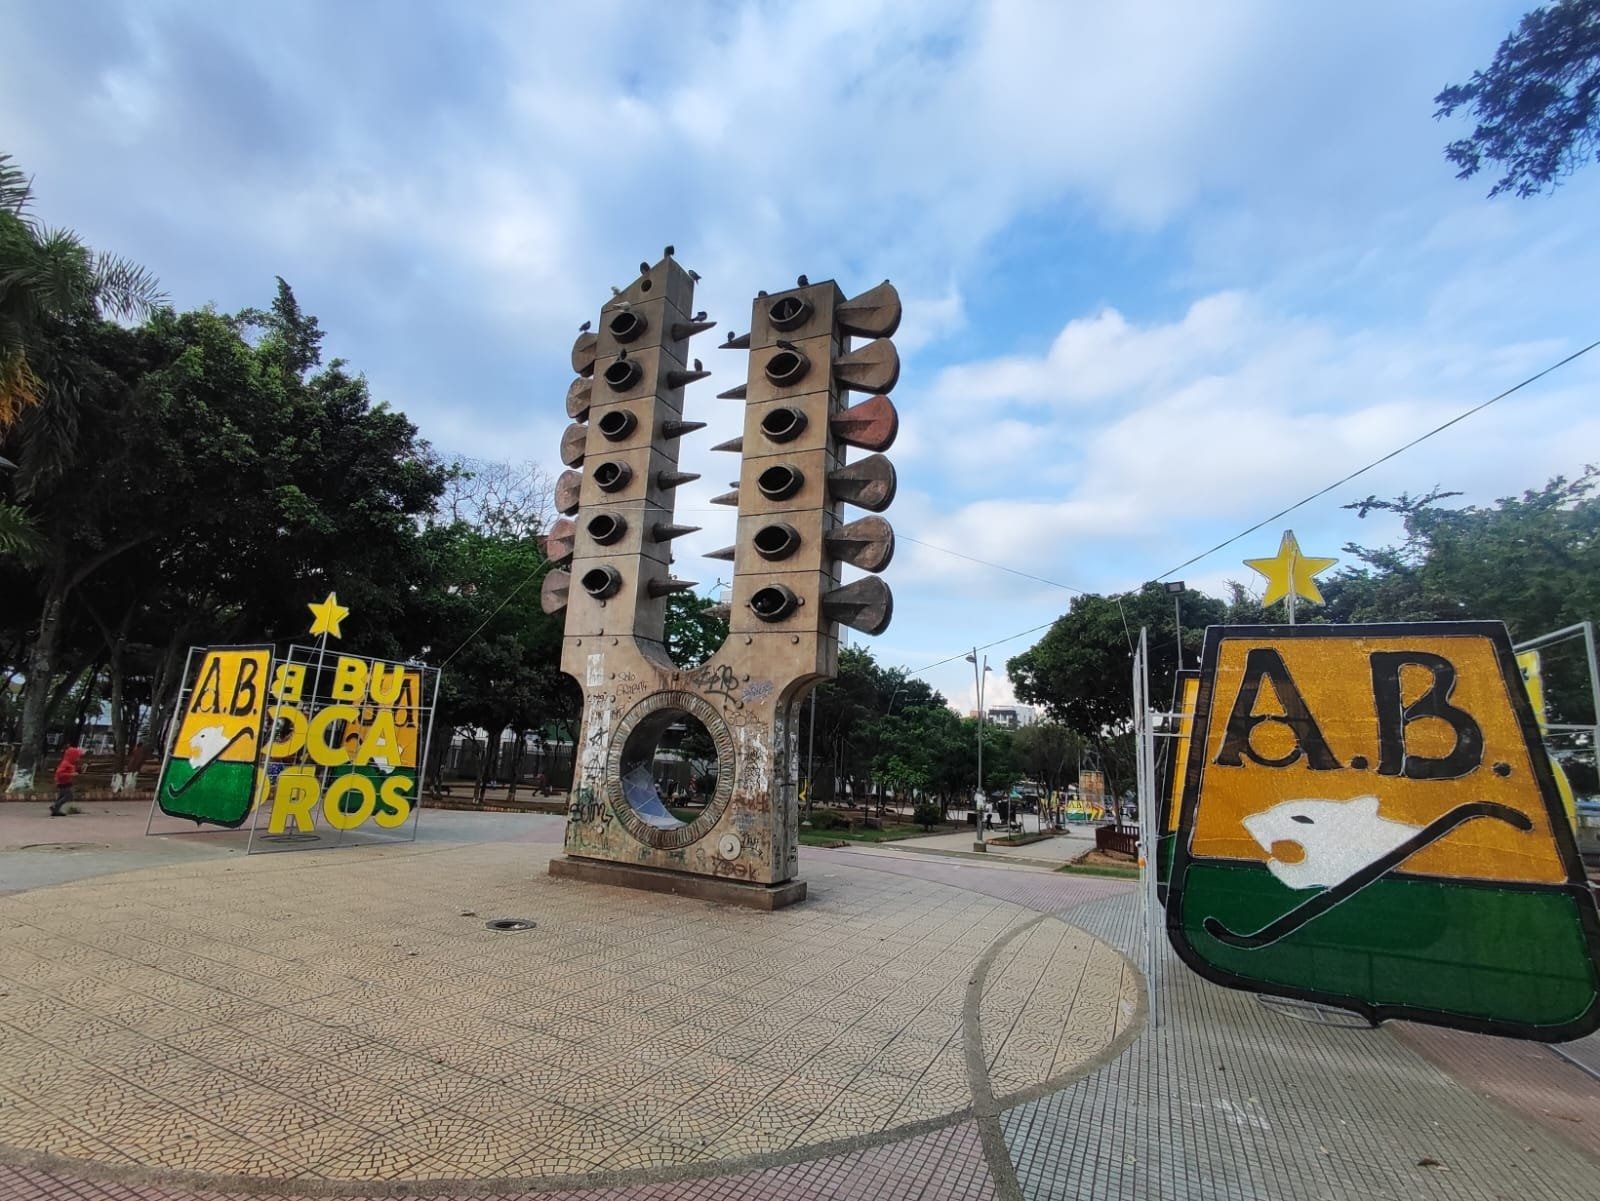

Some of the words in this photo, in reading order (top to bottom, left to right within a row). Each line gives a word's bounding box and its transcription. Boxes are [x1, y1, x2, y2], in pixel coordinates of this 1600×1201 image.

[191, 656, 258, 717] A.B.
[332, 656, 405, 705] BU
[307, 704, 403, 768] CA
[1213, 647, 1512, 780] A.B.
[267, 772, 415, 834] ROS
